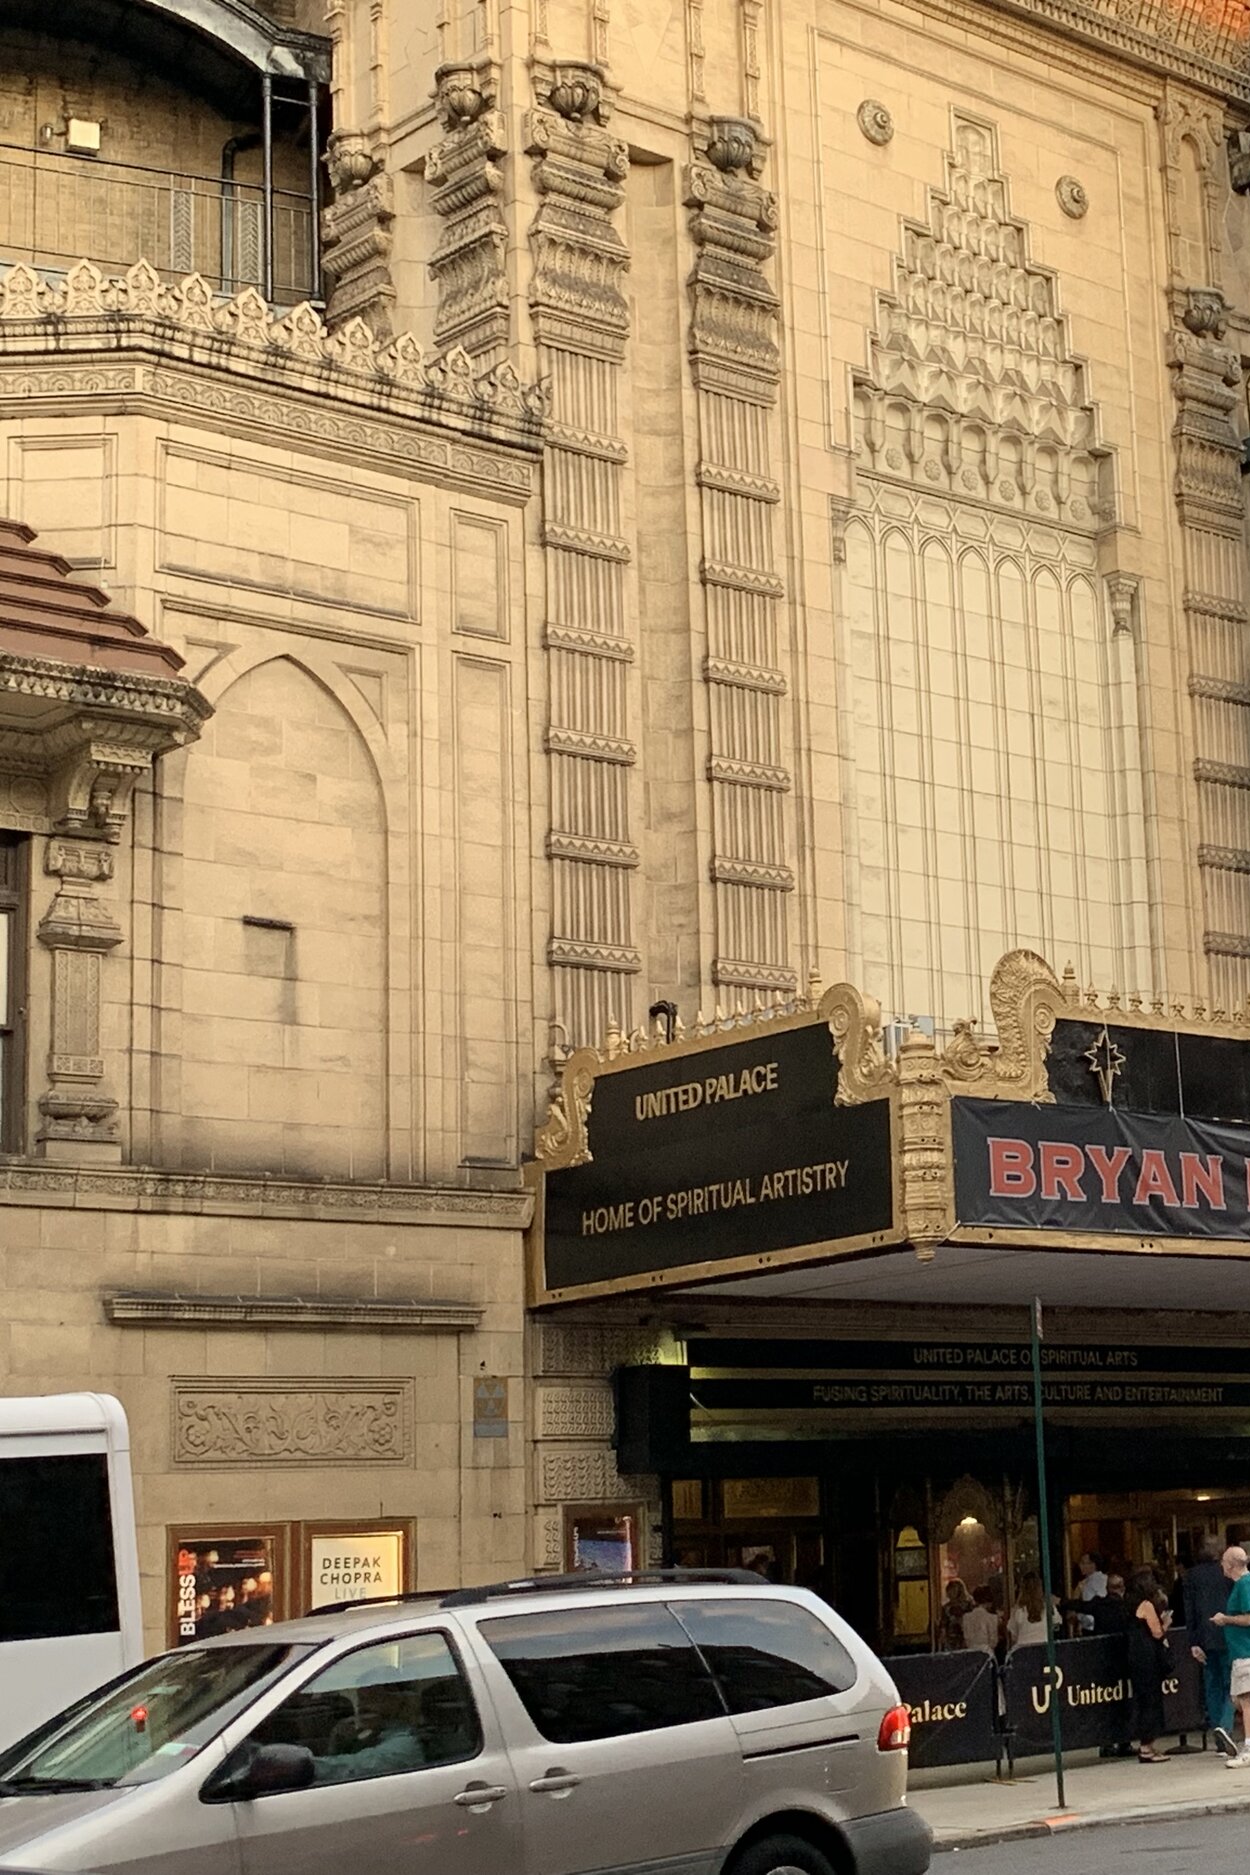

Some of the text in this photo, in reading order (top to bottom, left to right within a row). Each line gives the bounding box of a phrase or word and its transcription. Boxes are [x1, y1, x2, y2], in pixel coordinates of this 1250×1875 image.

[635, 1062, 779, 1122] UNITED PALACE
[986, 1137, 1228, 1211] BRYAN
[581, 1159, 849, 1236] HOME OF SPIRITUAL ARTISTRY
[913, 1349, 1138, 1367] UNITED PALACE O SPIRITUAL ARTS
[813, 1385, 867, 1401] FUSING
[870, 1385, 963, 1404] SPIRITUALITY,
[966, 1385, 992, 1400] THE
[1094, 1386, 1123, 1402] AND
[1125, 1386, 1224, 1403] ENTERTAINMENT
[321, 1556, 381, 1570] DEEPAK
[319, 1572, 383, 1585] CHOPRA
[334, 1587, 367, 1600] LIVE
[1067, 1679, 1123, 1706] United
